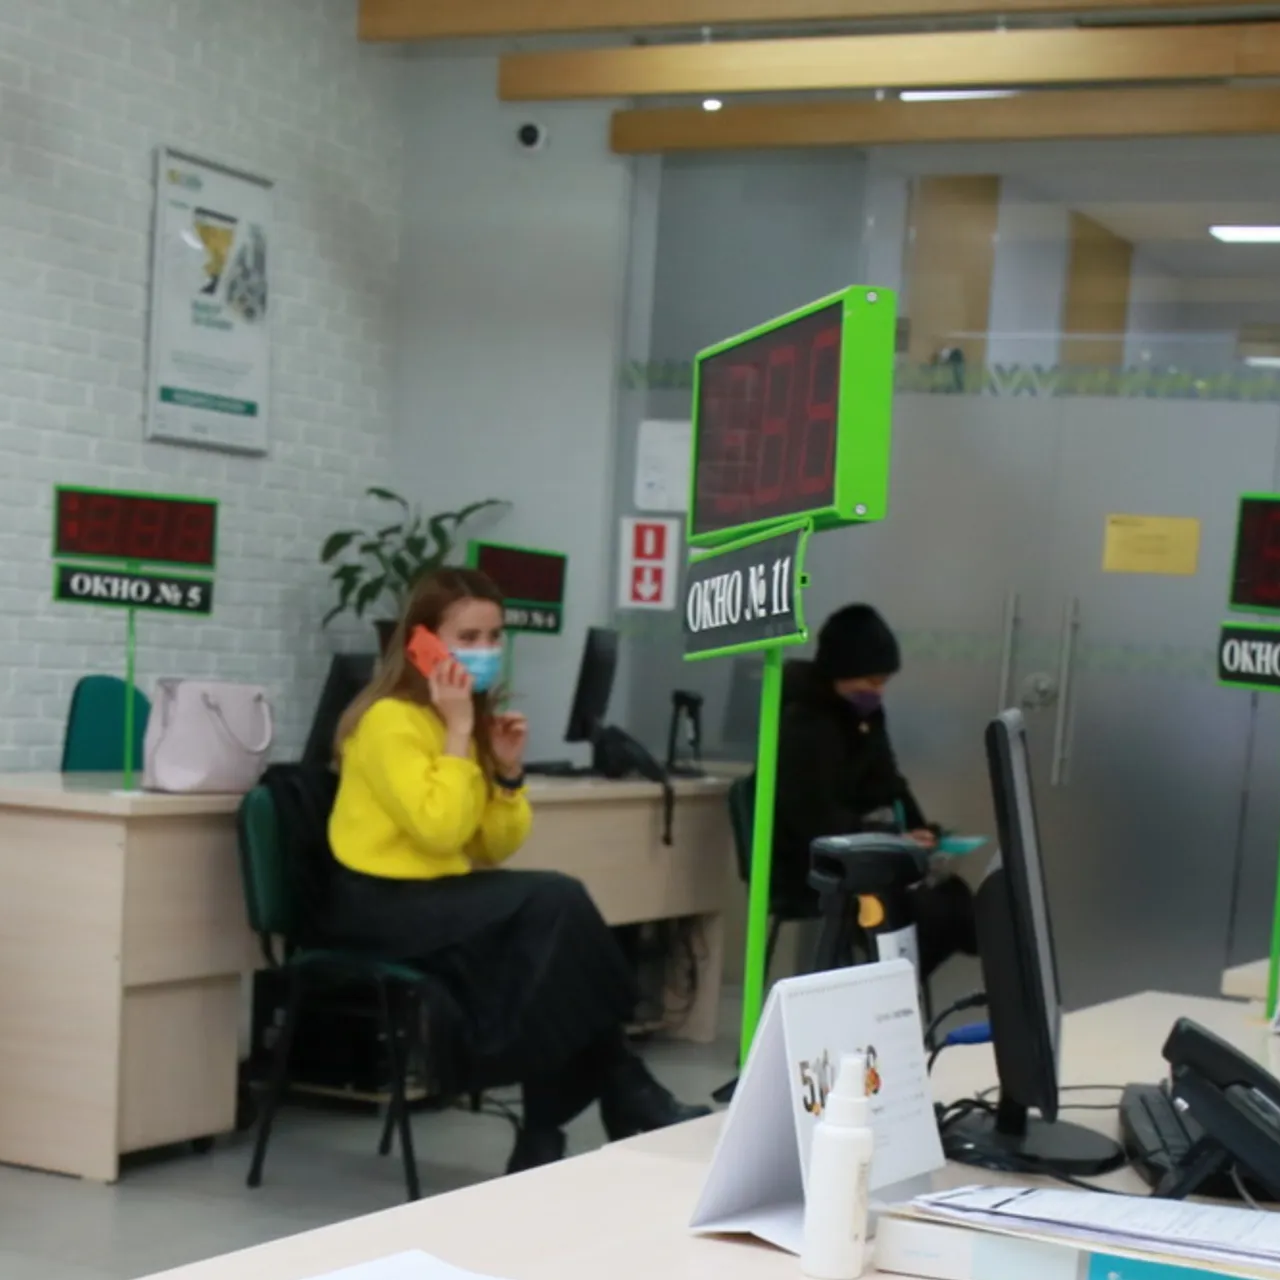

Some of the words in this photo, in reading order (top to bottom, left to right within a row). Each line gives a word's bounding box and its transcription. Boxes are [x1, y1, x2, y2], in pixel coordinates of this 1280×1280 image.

[69, 573, 152, 602] ОКНО
[154, 583, 183, 607] №
[186, 585, 203, 609] 5
[686, 569, 743, 633] ОКНО
[745, 563, 766, 622] №
[772, 556, 792, 615] 11
